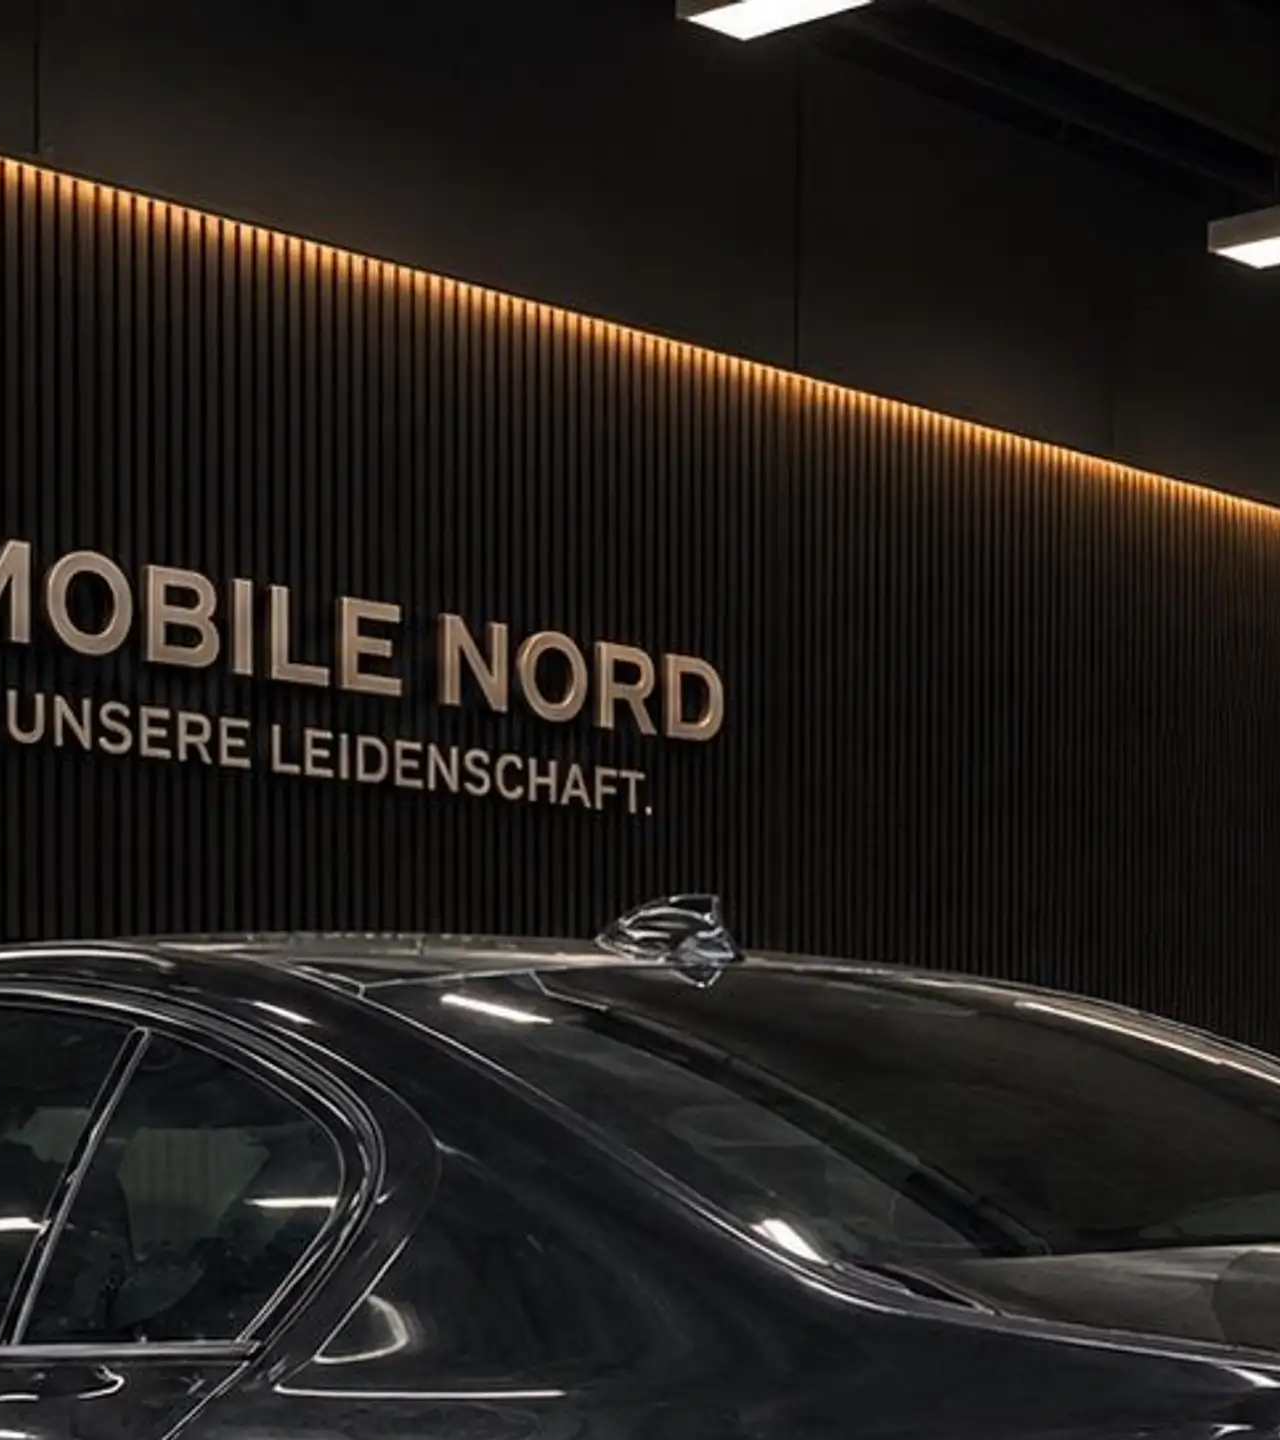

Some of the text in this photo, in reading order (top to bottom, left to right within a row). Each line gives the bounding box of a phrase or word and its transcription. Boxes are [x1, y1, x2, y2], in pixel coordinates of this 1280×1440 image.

[439, 611, 725, 742] NORD
[6, 687, 251, 769] UNSERE
[271, 723, 653, 815] LEIDENSCHAFT.
